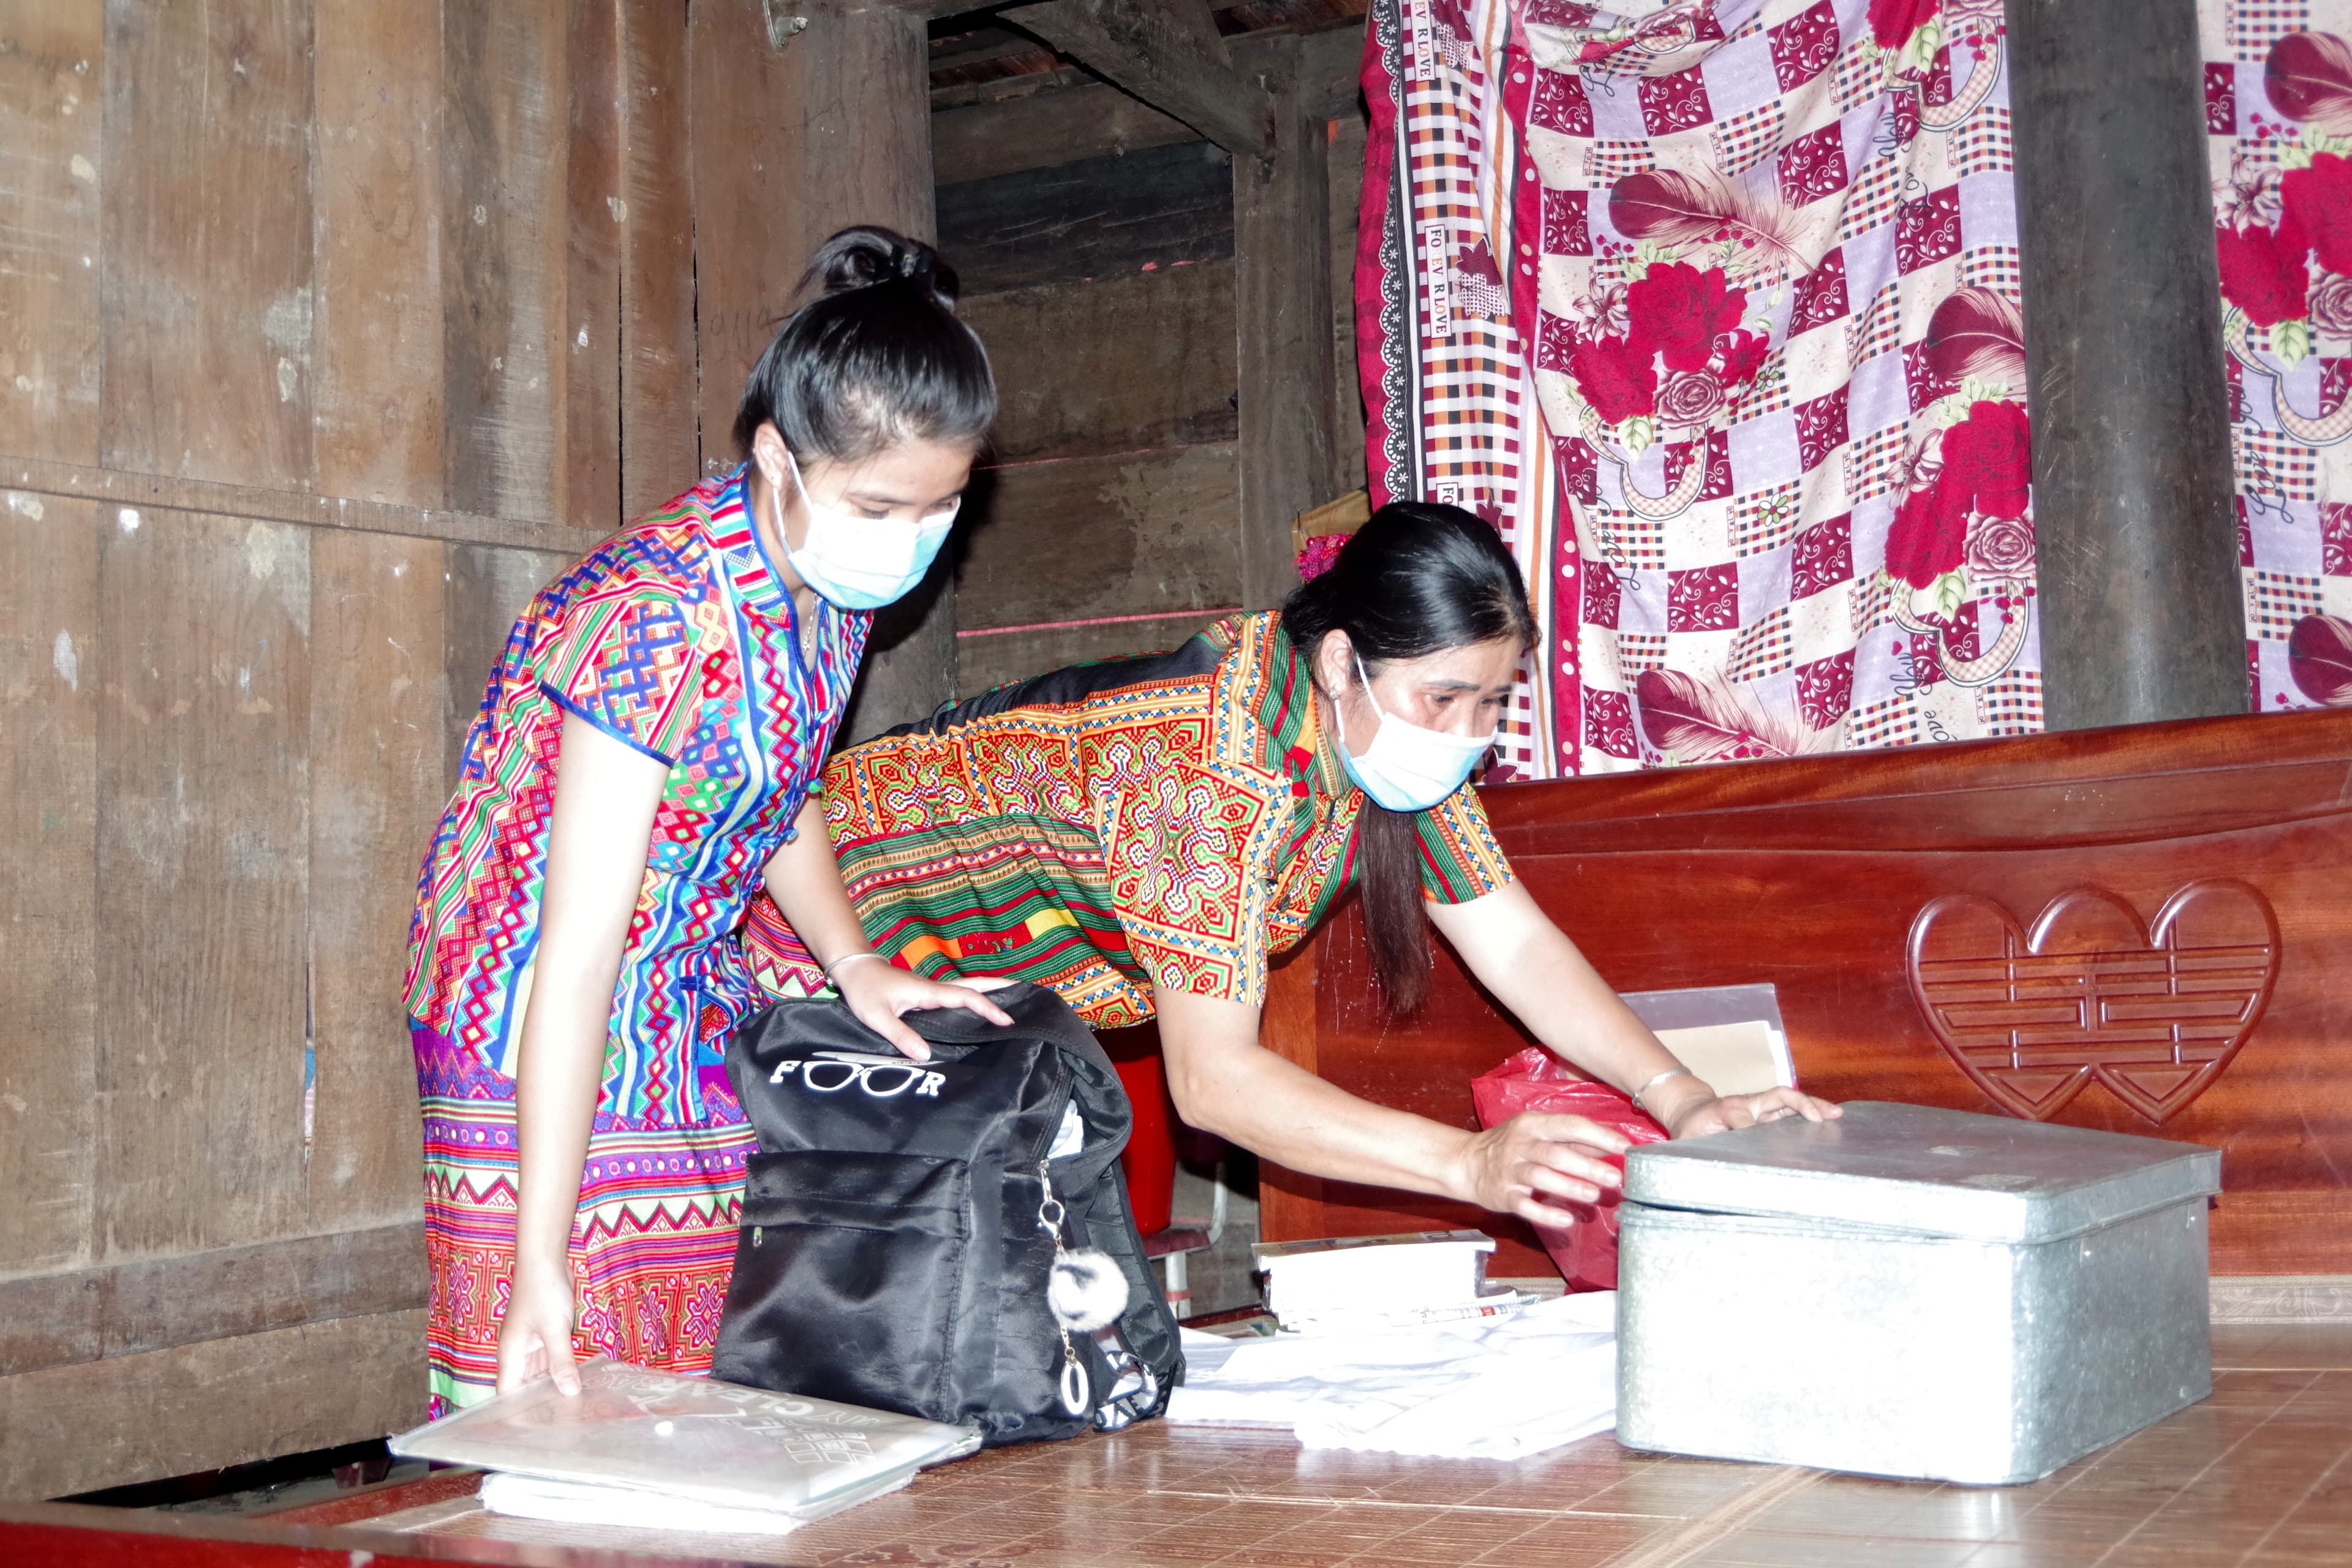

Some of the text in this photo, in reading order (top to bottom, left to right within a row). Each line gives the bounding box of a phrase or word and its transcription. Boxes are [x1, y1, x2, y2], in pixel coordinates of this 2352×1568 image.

[1417, 40, 1431, 77] LOVE
[1579, 62, 1615, 97] Lo
[1434, 297, 1447, 334] LOVE
[1923, 710, 1951, 743] ove
[648, 1378, 814, 1416] CLEAR
